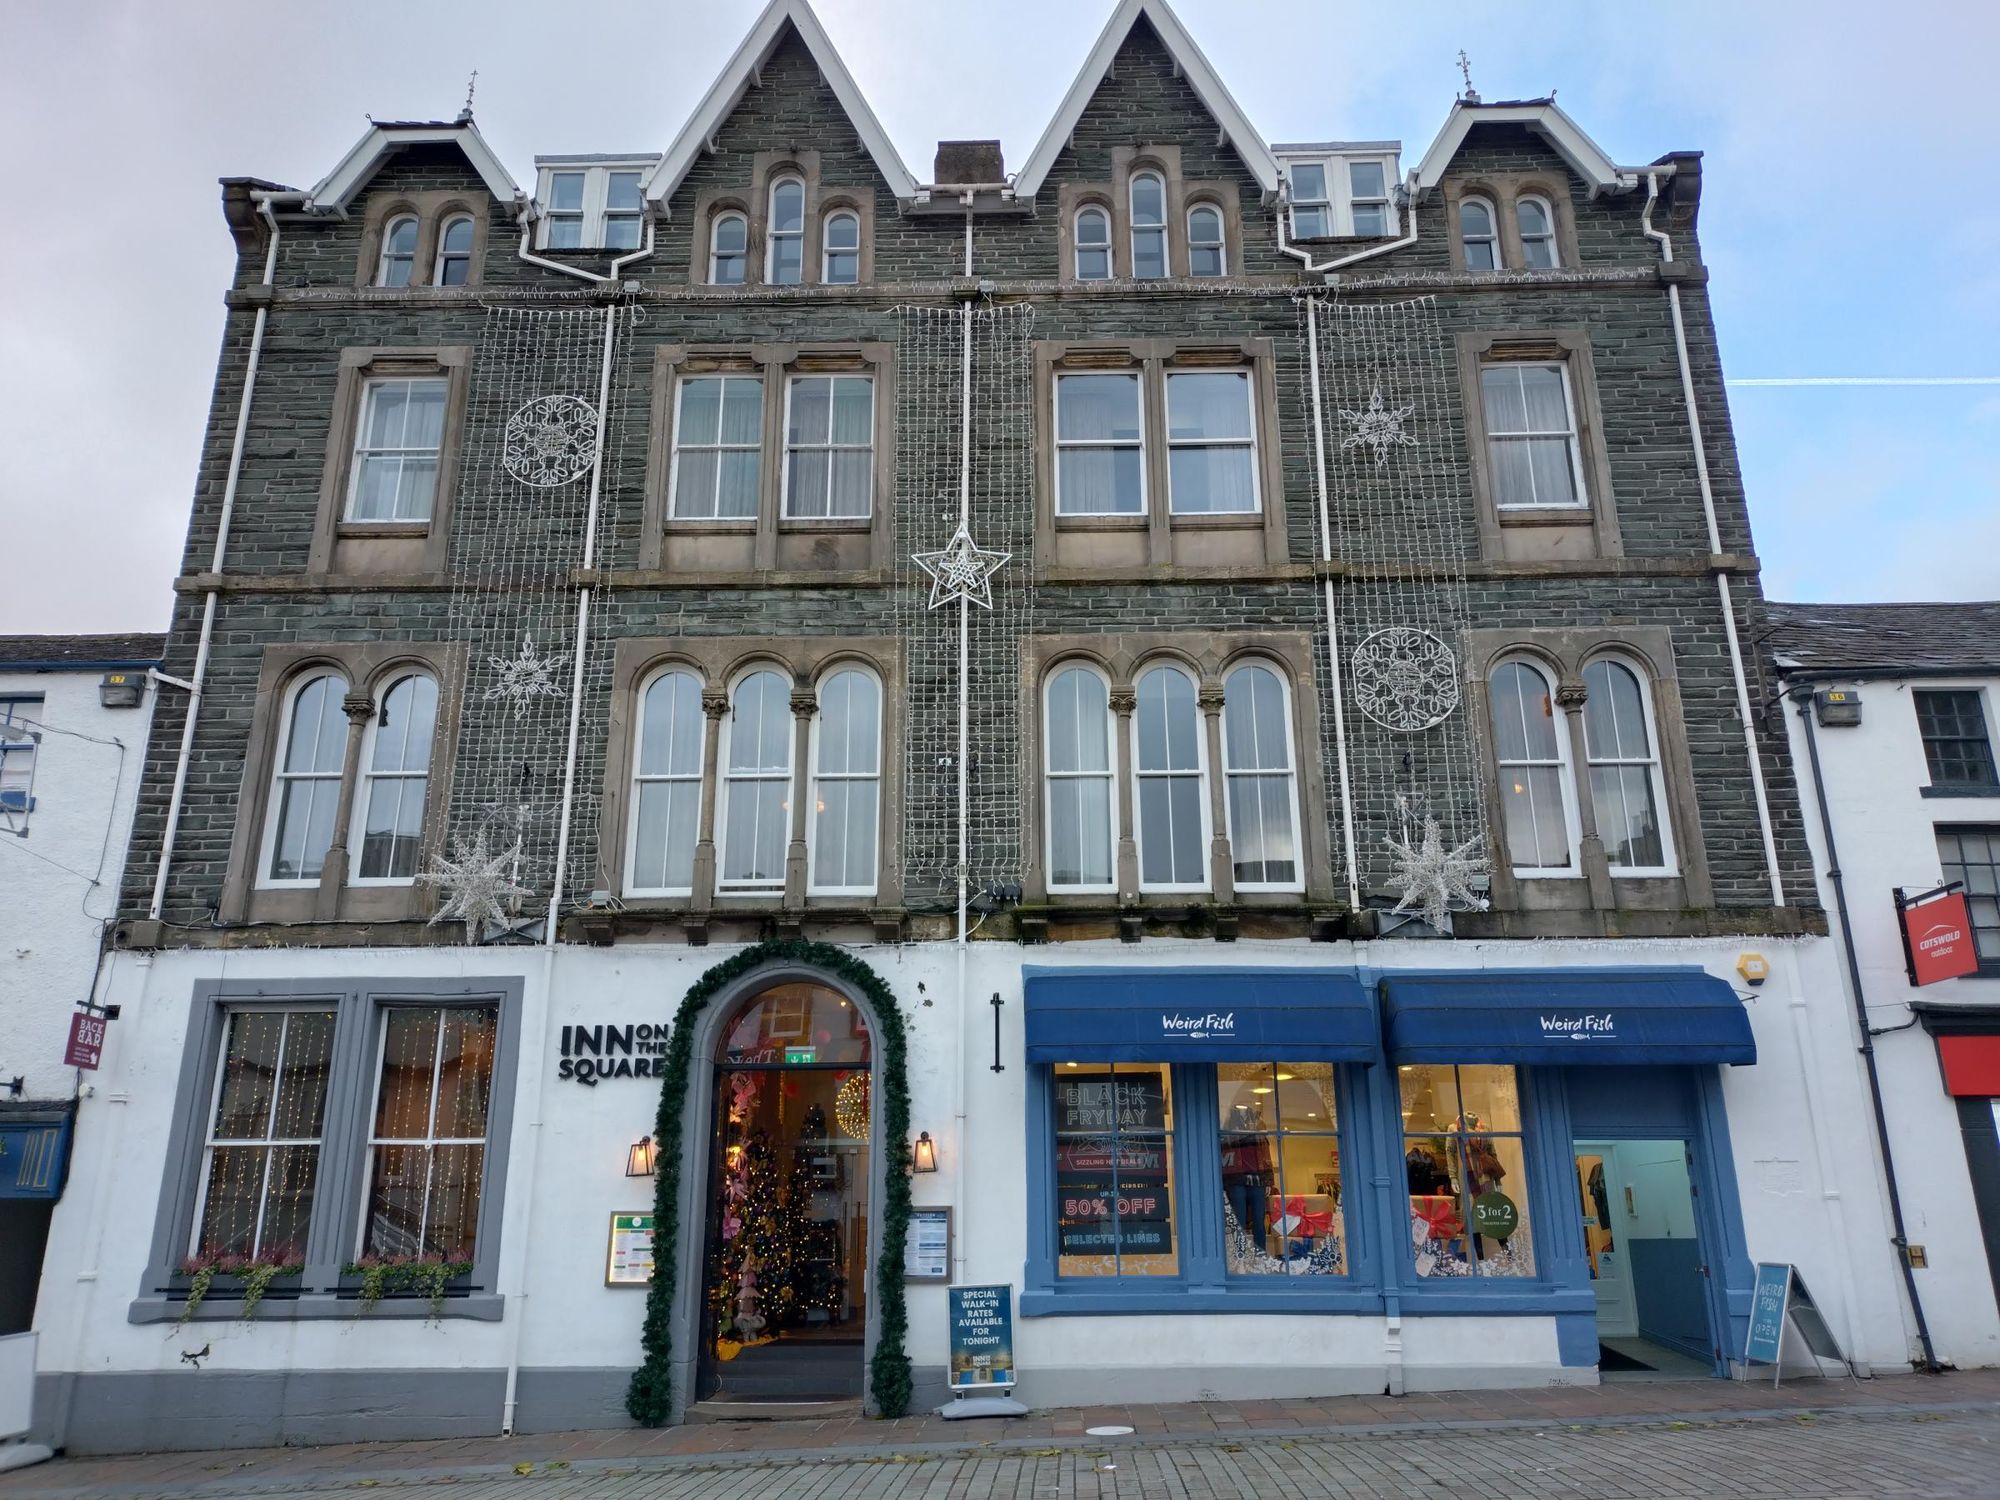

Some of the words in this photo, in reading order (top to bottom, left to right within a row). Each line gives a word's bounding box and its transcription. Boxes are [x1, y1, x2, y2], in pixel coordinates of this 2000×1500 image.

[1920, 930, 1960, 950] COTSWOLD
[1931, 946, 1953, 958] outdoor
[80, 1019, 104, 1034] BACK
[1162, 1013, 1204, 1029] Weird
[1206, 1012, 1234, 1029] Fish
[1540, 1014, 1583, 1031] Weird
[1585, 1013, 1613, 1031] Fish
[77, 1029, 101, 1047] BAR
[636, 1023, 669, 1040] ON
[561, 1025, 634, 1056] INN
[636, 1041, 667, 1054] THE
[558, 1058, 666, 1087] SQUARE
[1066, 1087, 1146, 1106] BLACK
[1067, 1109, 1147, 1126] FRYDAY
[1065, 1199, 1107, 1216] 50%
[1117, 1198, 1156, 1215] OFF
[1477, 1205, 1486, 1219] 3
[1488, 1207, 1501, 1216] for
[1502, 1205, 1512, 1219] 2
[1127, 1232, 1160, 1244] LINES
[963, 1291, 997, 1299] SPECIAL
[1760, 1284, 1784, 1297] WEIRD
[961, 1300, 999, 1309] WALK-IN
[967, 1309, 993, 1318] RATES
[958, 1317, 1003, 1327] AVAILABLE
[972, 1327, 989, 1336] FOR
[1756, 1324, 1776, 1337] OPEN
[962, 1336, 1000, 1346] TONIGHT
